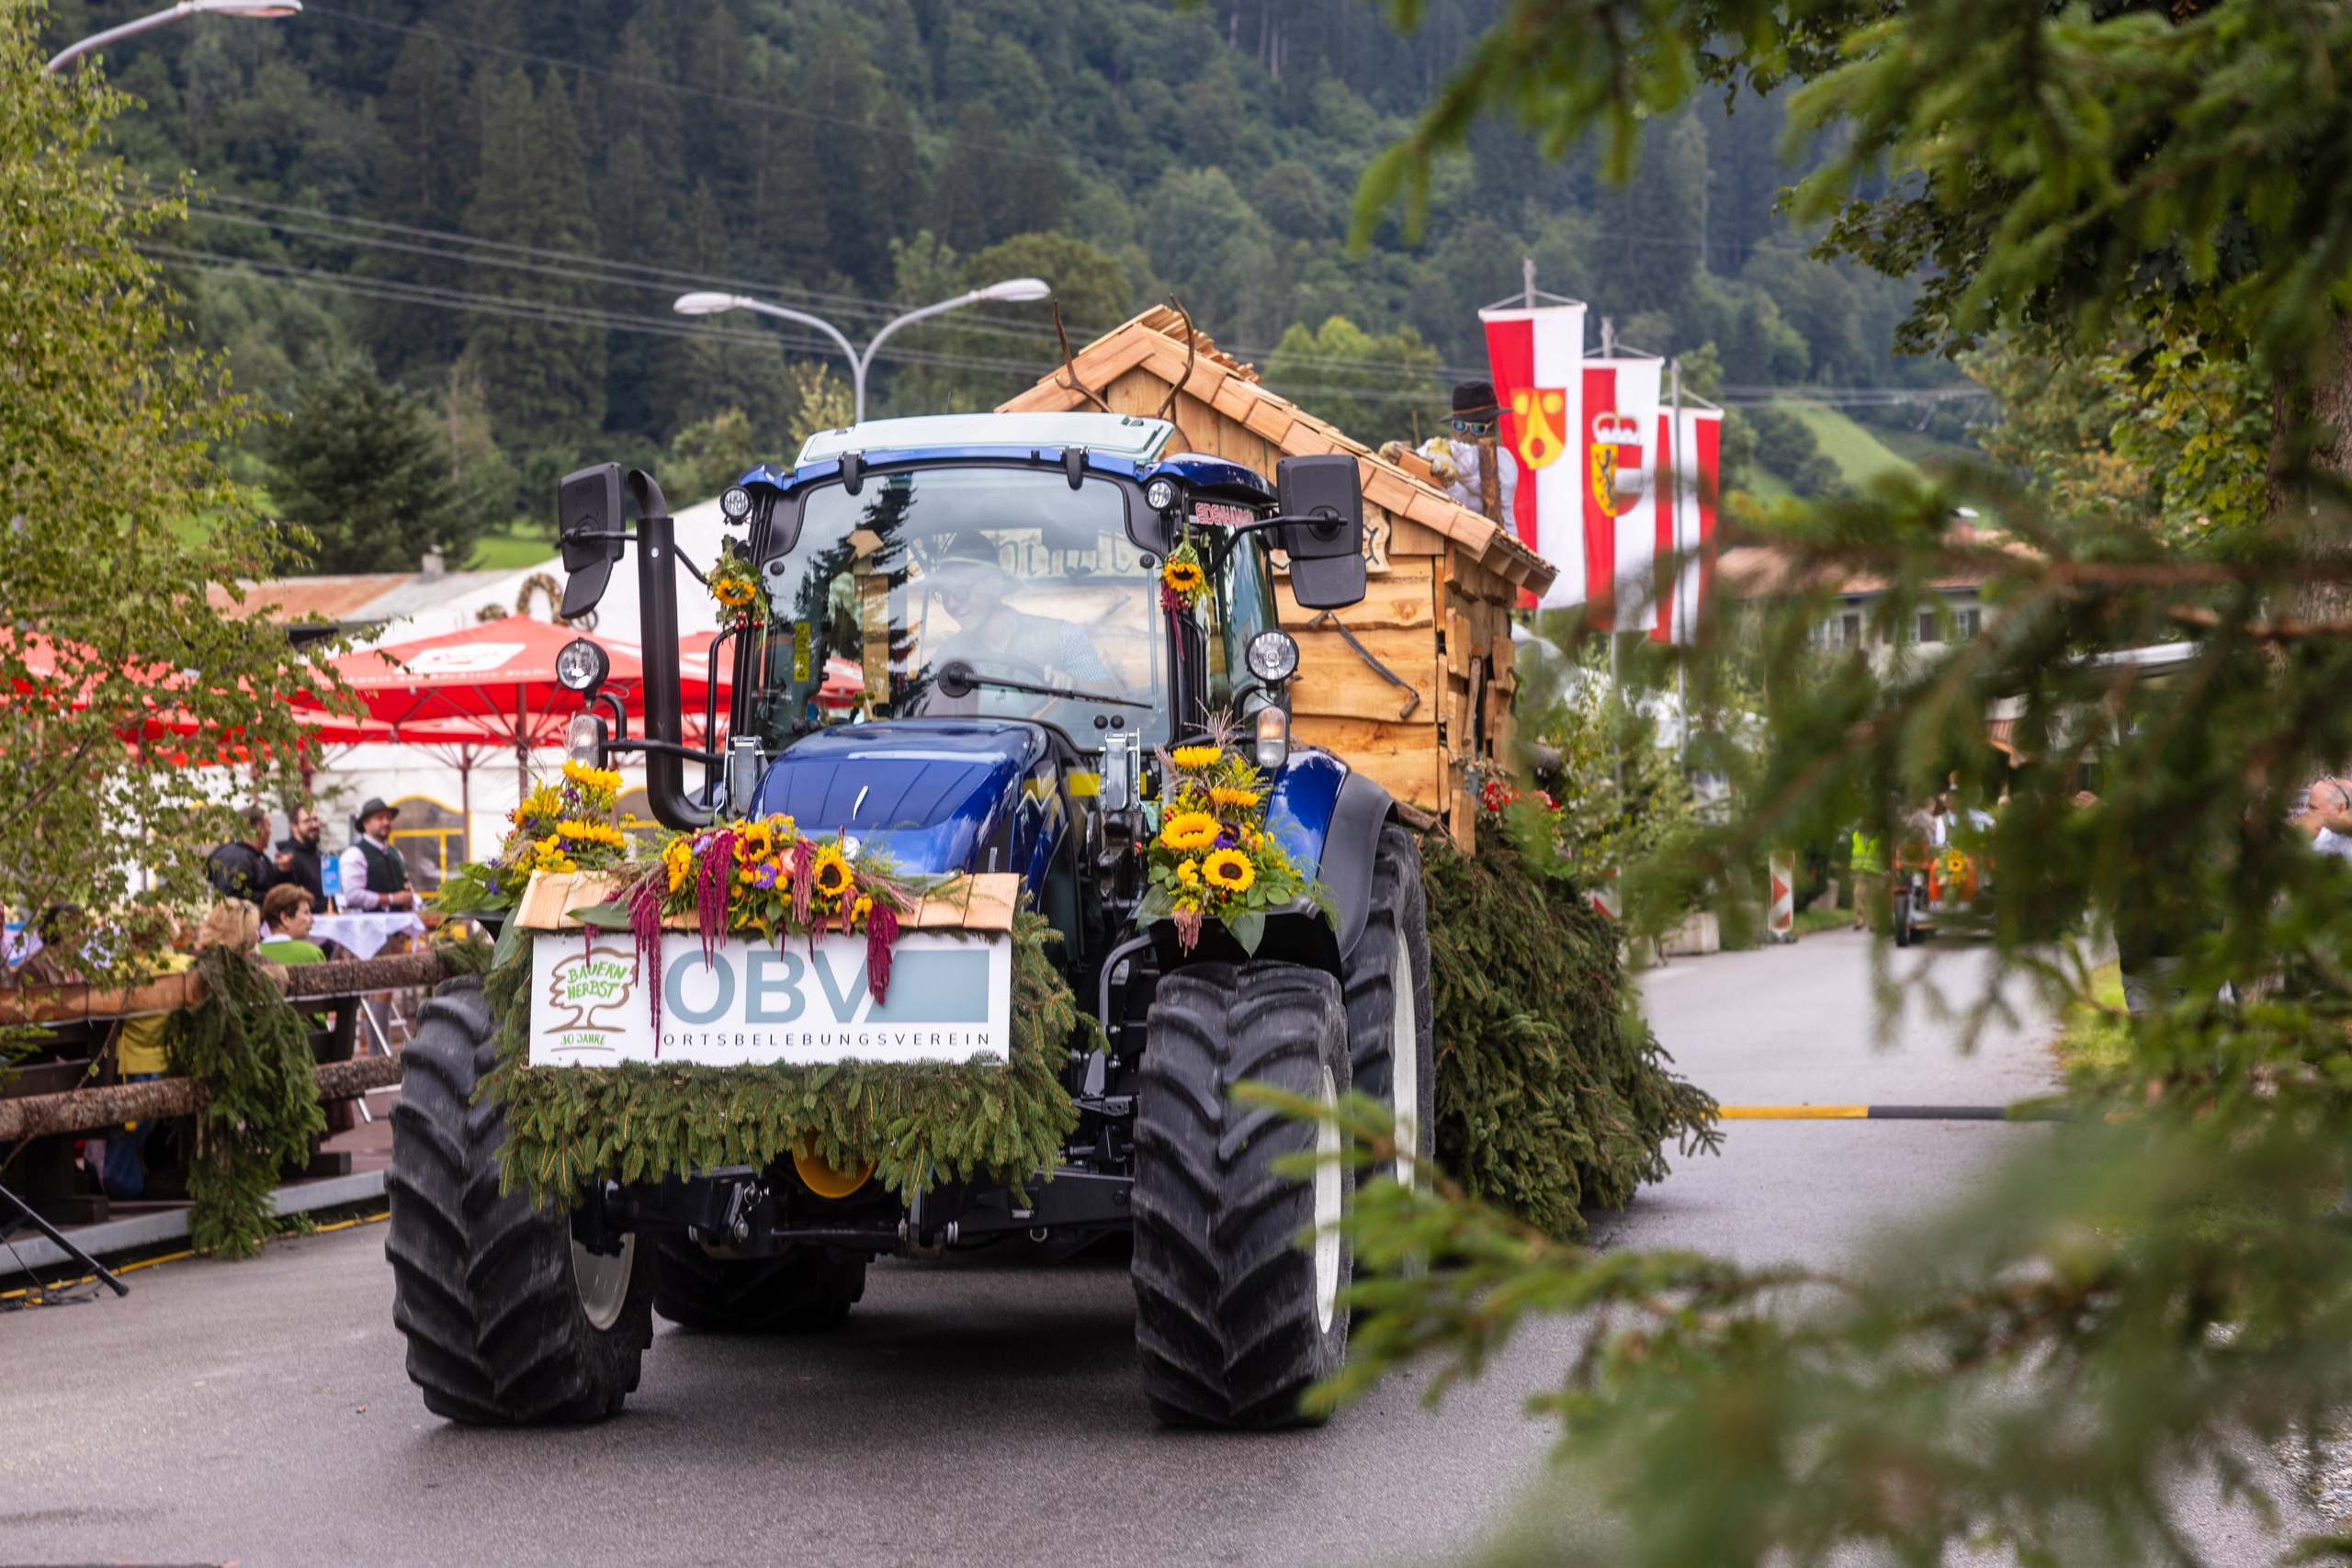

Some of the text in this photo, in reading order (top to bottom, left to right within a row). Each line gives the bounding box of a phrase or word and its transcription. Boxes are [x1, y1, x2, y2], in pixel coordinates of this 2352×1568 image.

[568, 961, 628, 983] BAUERN
[567, 981, 620, 999] HERBST
[664, 950, 876, 1024] OBV
[561, 1033, 574, 1045] 30
[664, 1032, 989, 1046] ORTSBELEBUNGSVEREIN
